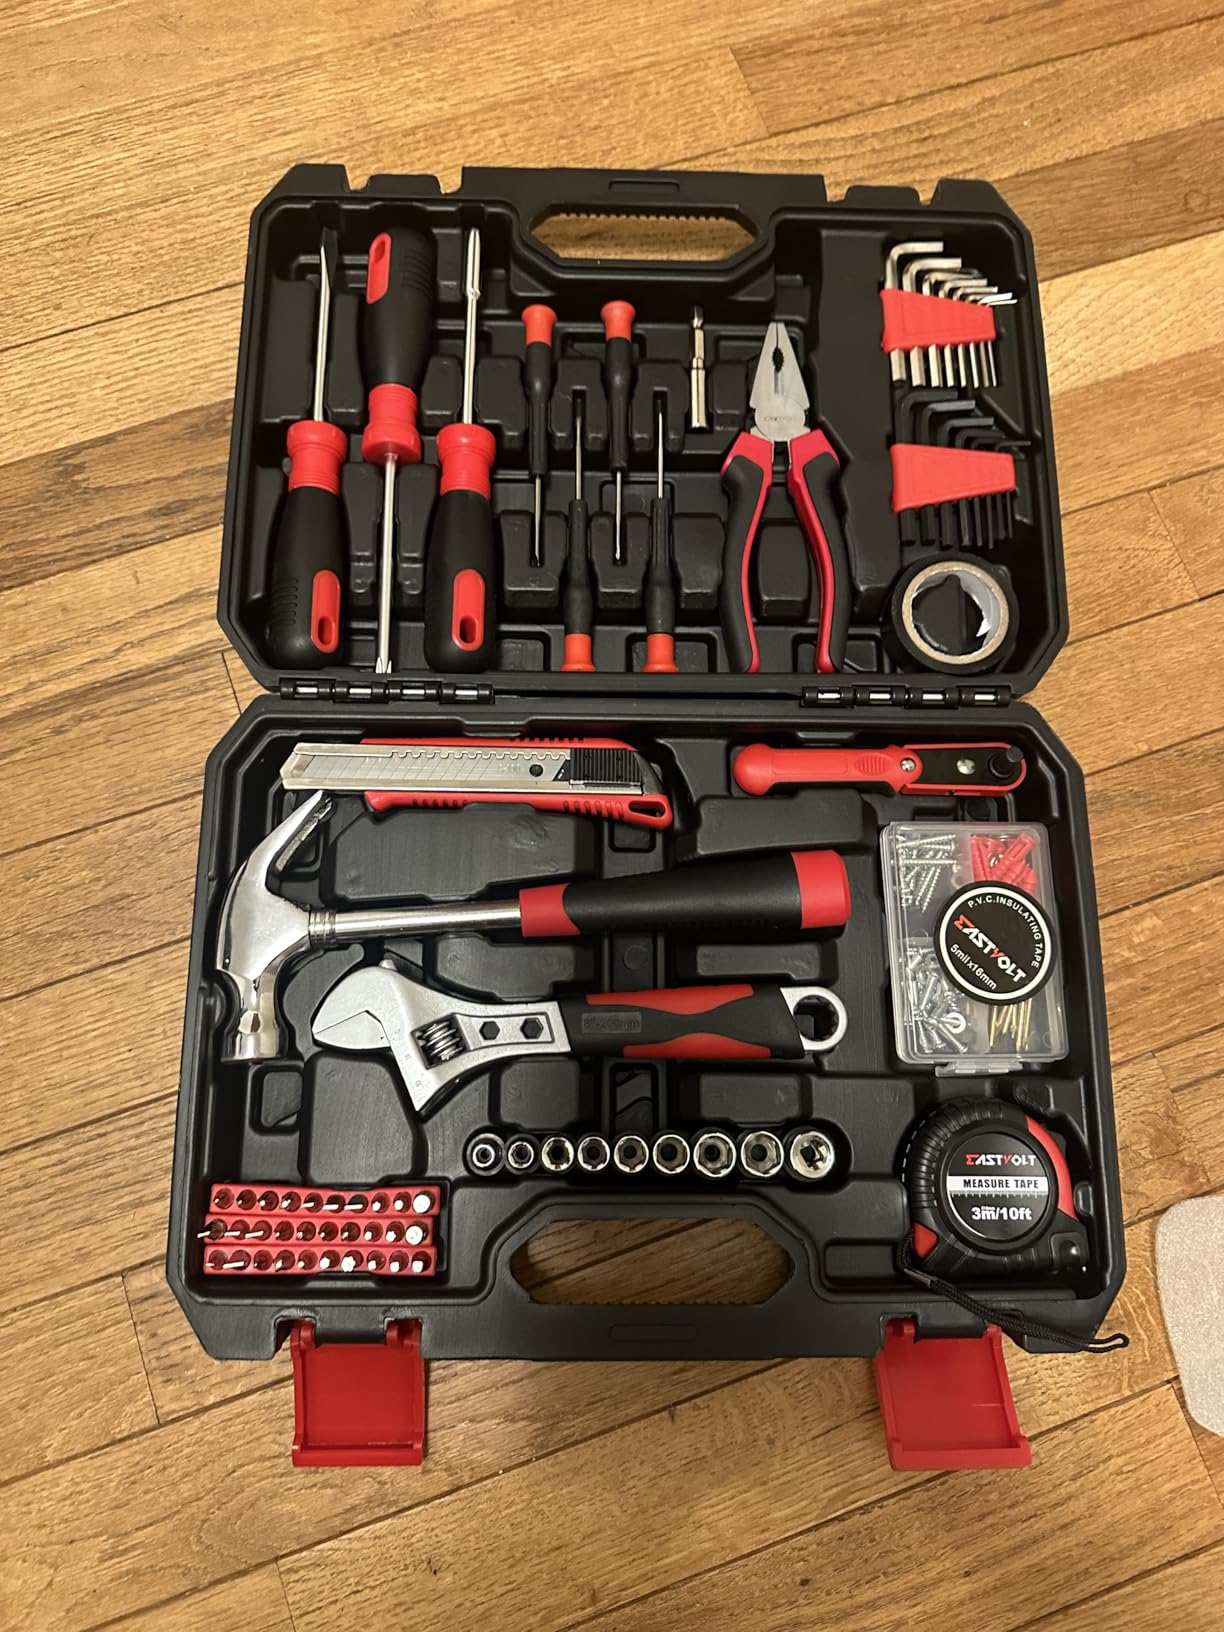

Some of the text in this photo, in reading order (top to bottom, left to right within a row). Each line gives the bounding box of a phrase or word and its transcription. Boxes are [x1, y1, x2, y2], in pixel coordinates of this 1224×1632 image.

[953, 914, 1026, 983] EASTVOLT
[1031, 942, 1043, 968] TAPE
[965, 1154, 1036, 1166] EASTVOLT
[963, 1179, 1039, 1188] MEASURE TAPE
[971, 1206, 1032, 1220] 3m/10ft
